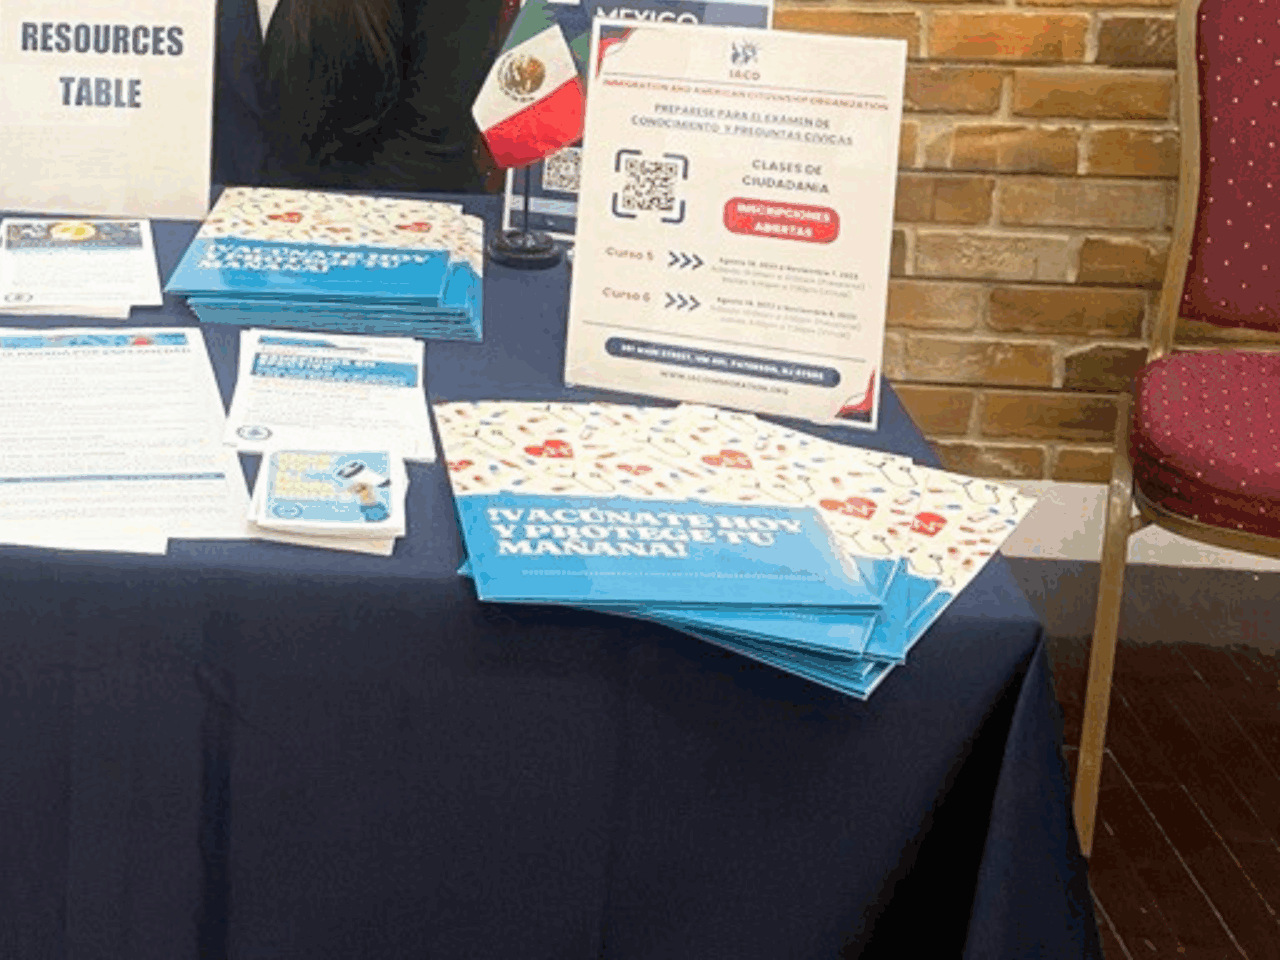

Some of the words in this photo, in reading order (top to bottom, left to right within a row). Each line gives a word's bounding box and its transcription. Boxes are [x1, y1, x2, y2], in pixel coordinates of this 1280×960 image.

[21, 22, 184, 56] RESOURCES
[59, 76, 142, 108] TABLE
[751, 159, 803, 174] CLASES
[805, 164, 822, 176] DE
[604, 246, 645, 260] Curso
[714, 515, 801, 533] HOY
[492, 524, 517, 539] Y
[524, 524, 717, 543] PROTEGE
[718, 529, 776, 546] TU
